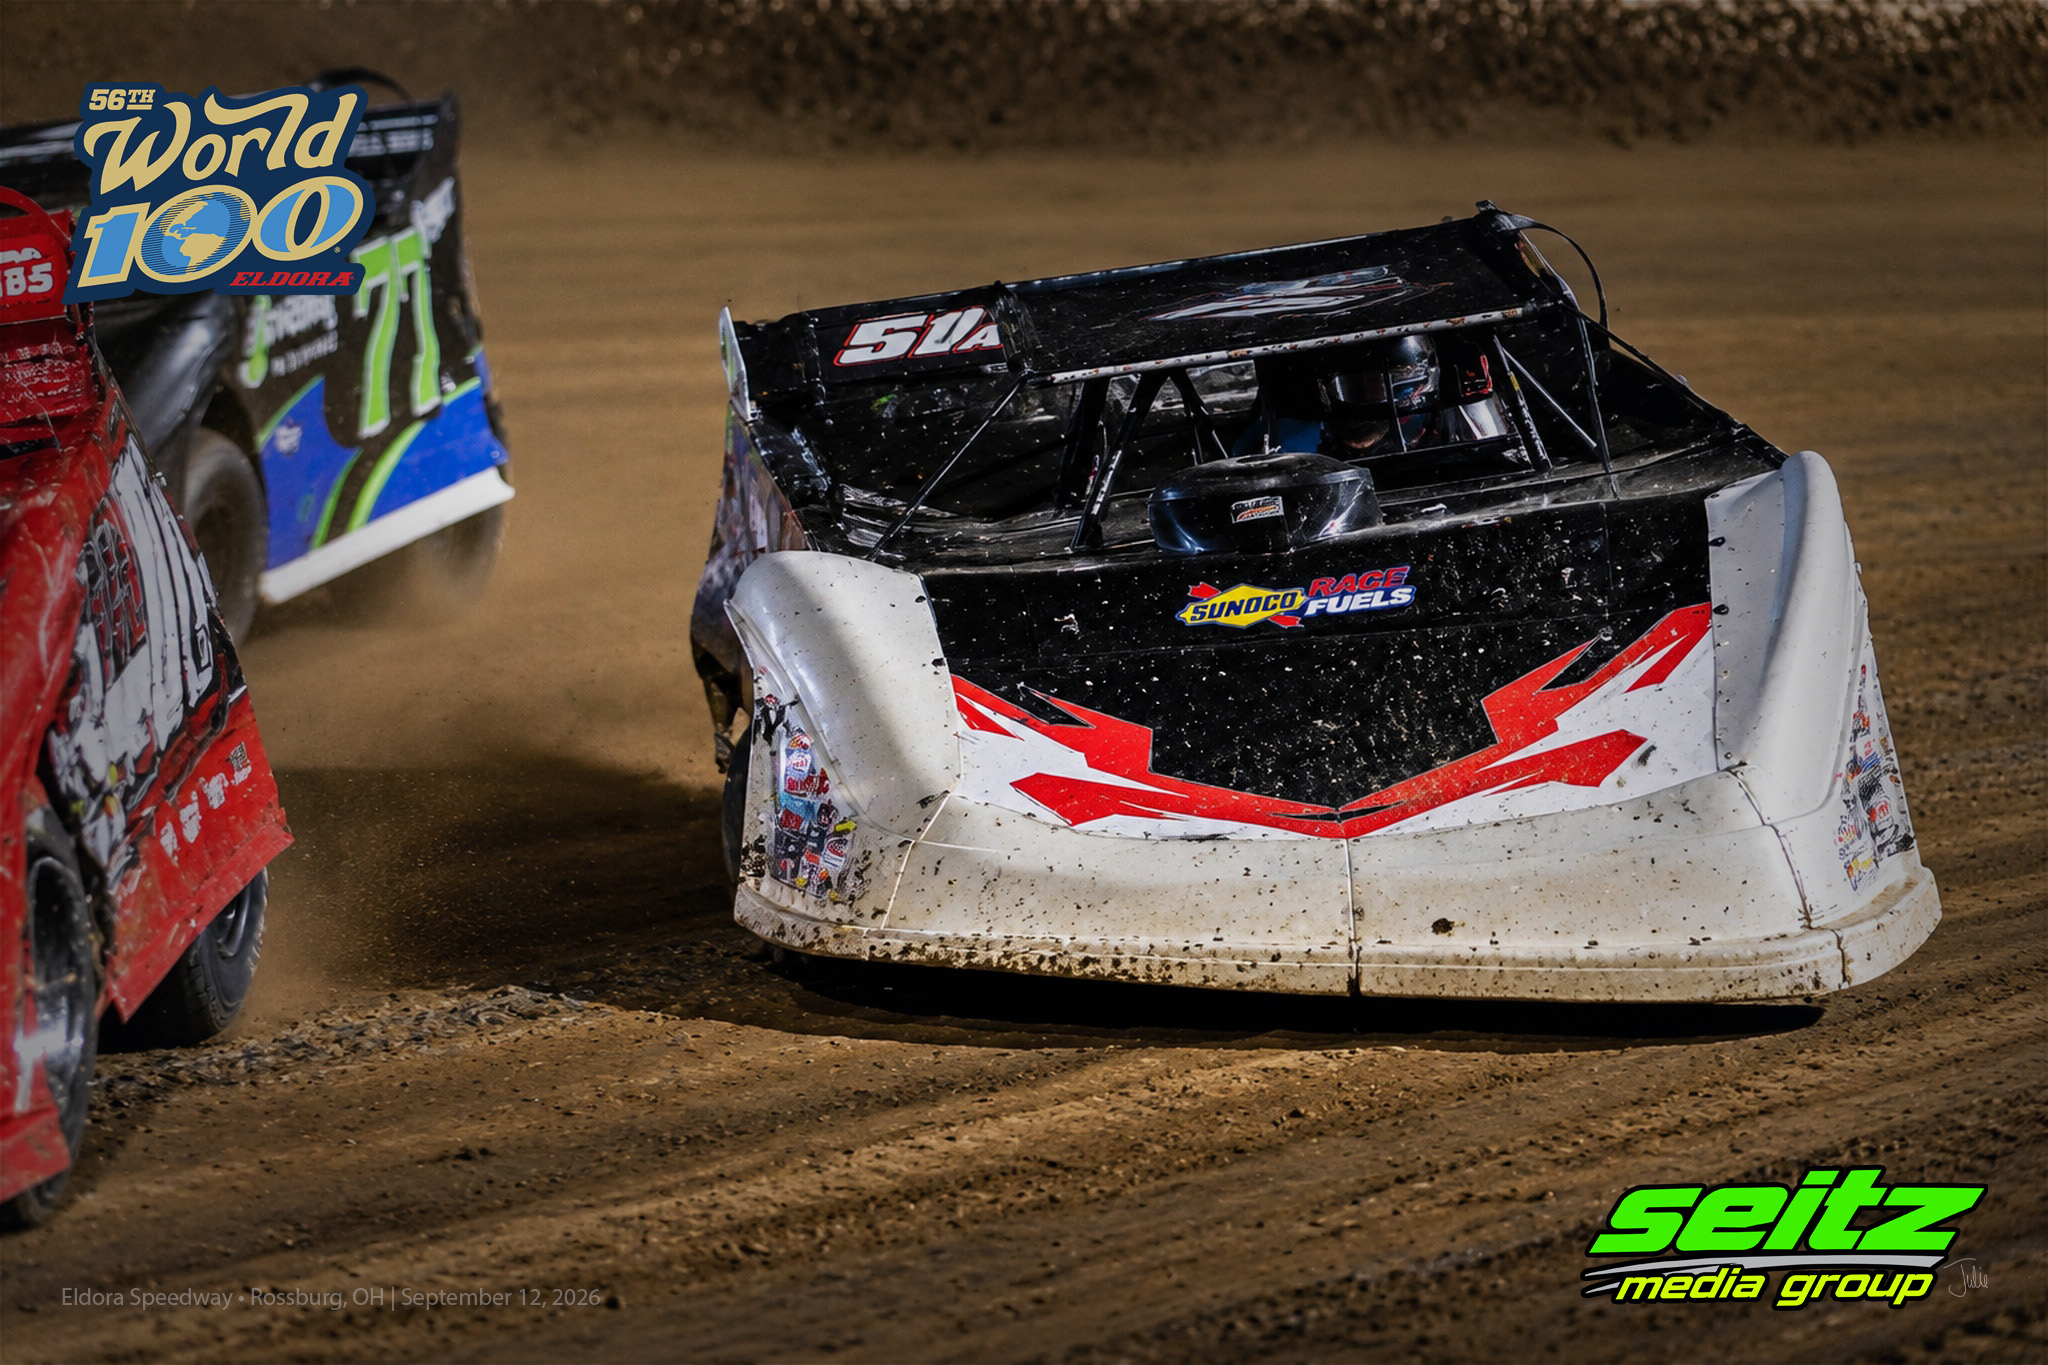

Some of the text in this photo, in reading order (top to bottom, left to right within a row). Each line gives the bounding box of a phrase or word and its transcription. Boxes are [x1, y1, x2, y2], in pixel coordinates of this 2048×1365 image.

[1190, 566, 1411, 623] SUNOCO RACE
[1304, 587, 1415, 617] FUELS
